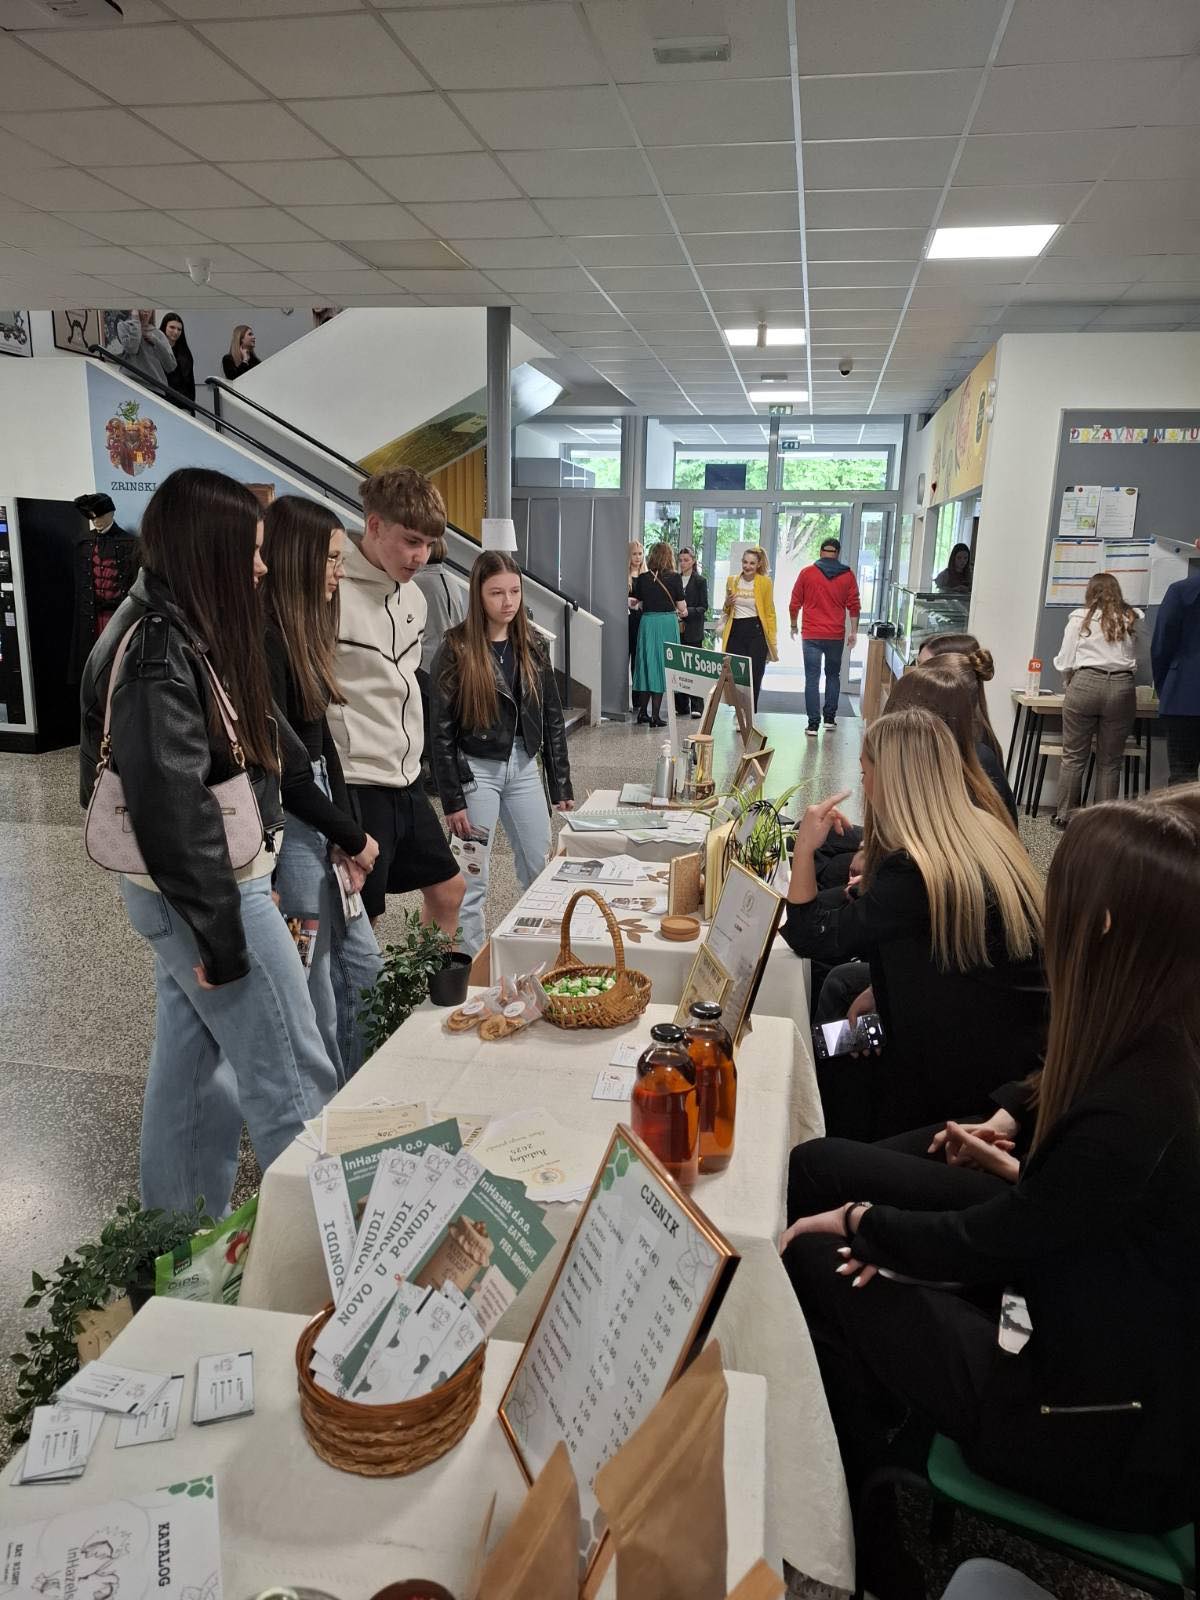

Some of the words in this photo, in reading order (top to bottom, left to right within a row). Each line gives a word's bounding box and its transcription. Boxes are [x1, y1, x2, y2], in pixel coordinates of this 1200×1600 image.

[681, 651, 693, 669] VT
[373, 1200, 414, 1252] ONUDI
[479, 1177, 513, 1214] InHazels
[511, 1210, 530, 1235] d.o.o.
[640, 1183, 680, 1238] CJENIK
[336, 1281, 374, 1326] NOVO
[374, 1263, 388, 1277] U
[389, 1200, 438, 1259] PONUDI
[157, 1522, 171, 1587] KATALOG
